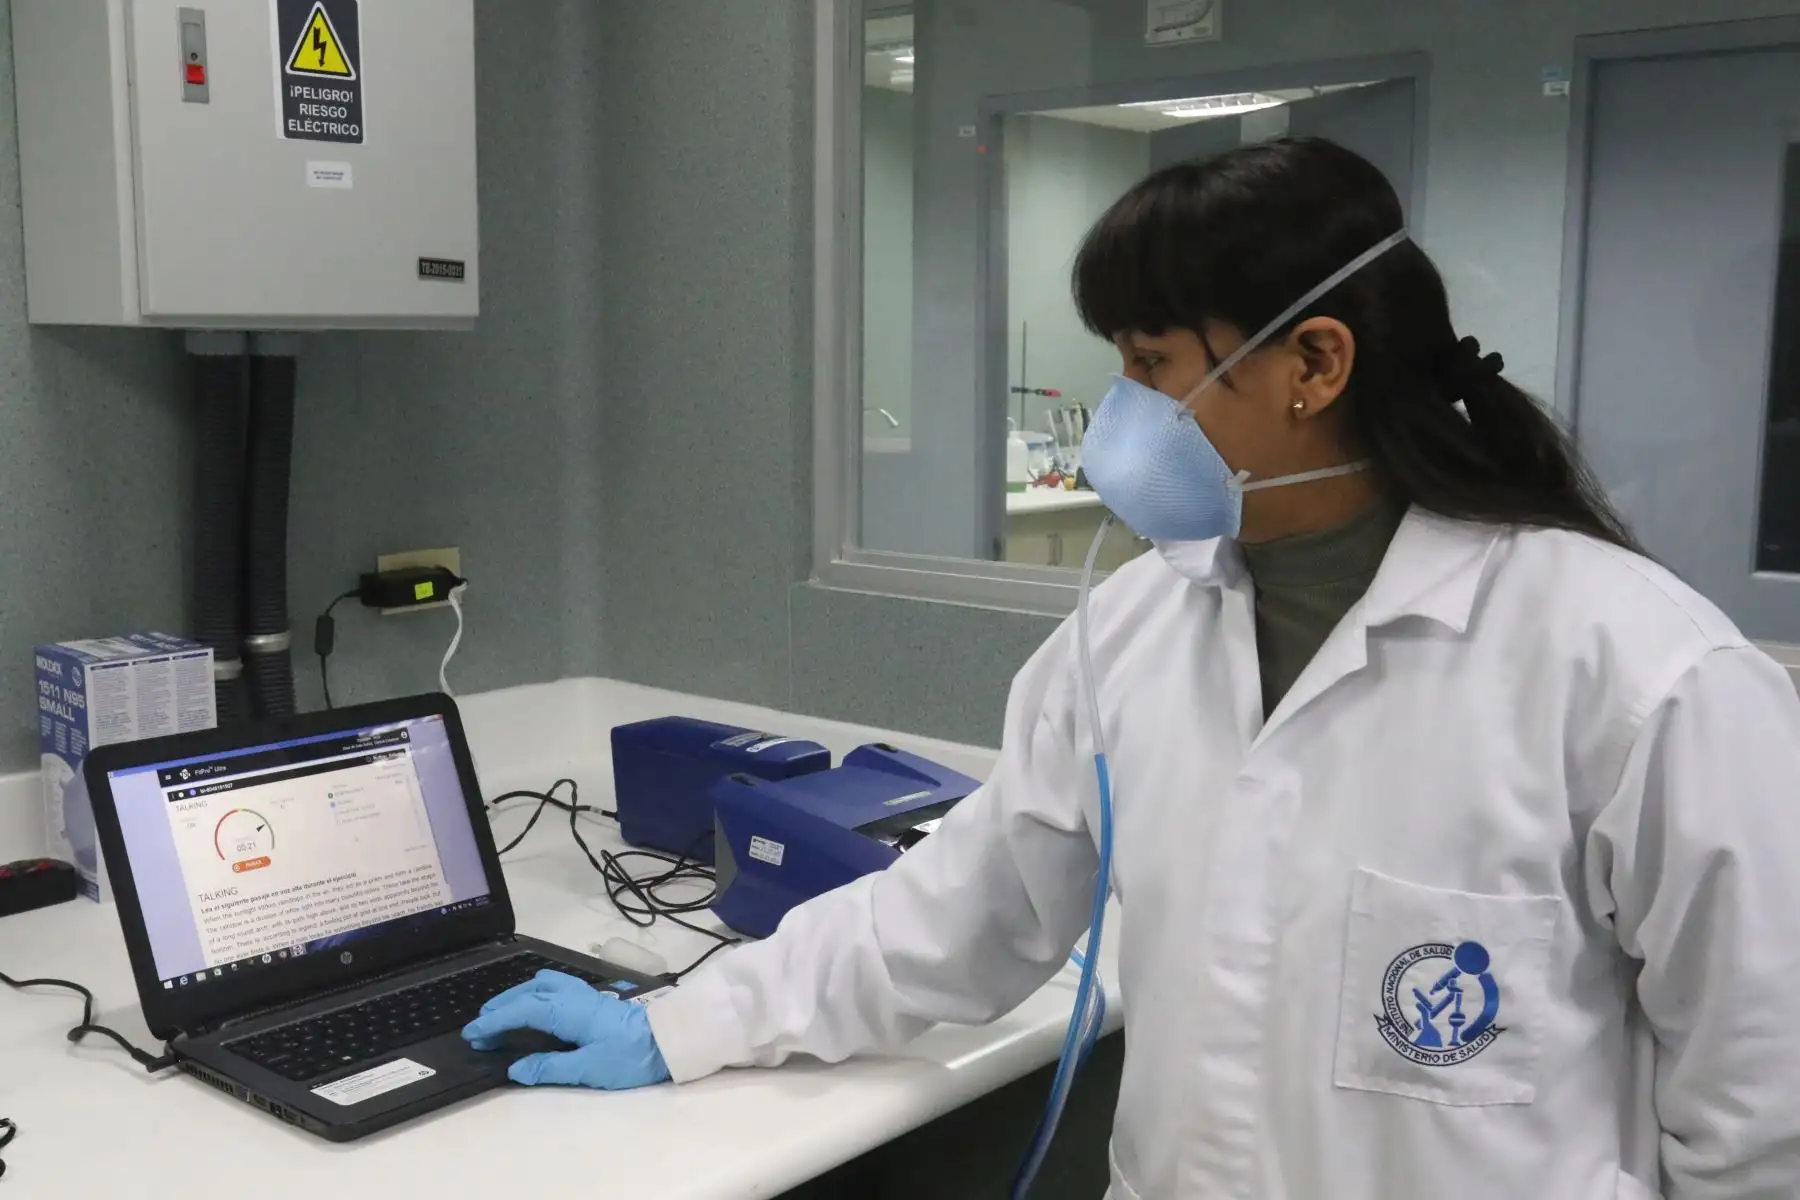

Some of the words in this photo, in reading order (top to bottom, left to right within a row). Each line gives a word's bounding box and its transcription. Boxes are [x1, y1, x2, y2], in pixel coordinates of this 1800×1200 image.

[290, 85, 354, 103] ¡PELIGRO!
[299, 103, 347, 119] RIESGO
[288, 117, 359, 136] ELÉCTRICO
[39, 680, 60, 699] 1511
[63, 687, 85, 709] N95
[39, 695, 76, 721] SMALL
[199, 888, 238, 903] TALKING
[1386, 957, 1410, 996] NACIONAL
[1410, 950, 1421, 960] DE
[1423, 946, 1453, 956] SALUD
[1383, 1026, 1440, 1063] MINISTERIO
[1443, 1051, 1458, 1063] DE
[1459, 1032, 1491, 1059] SALUD
